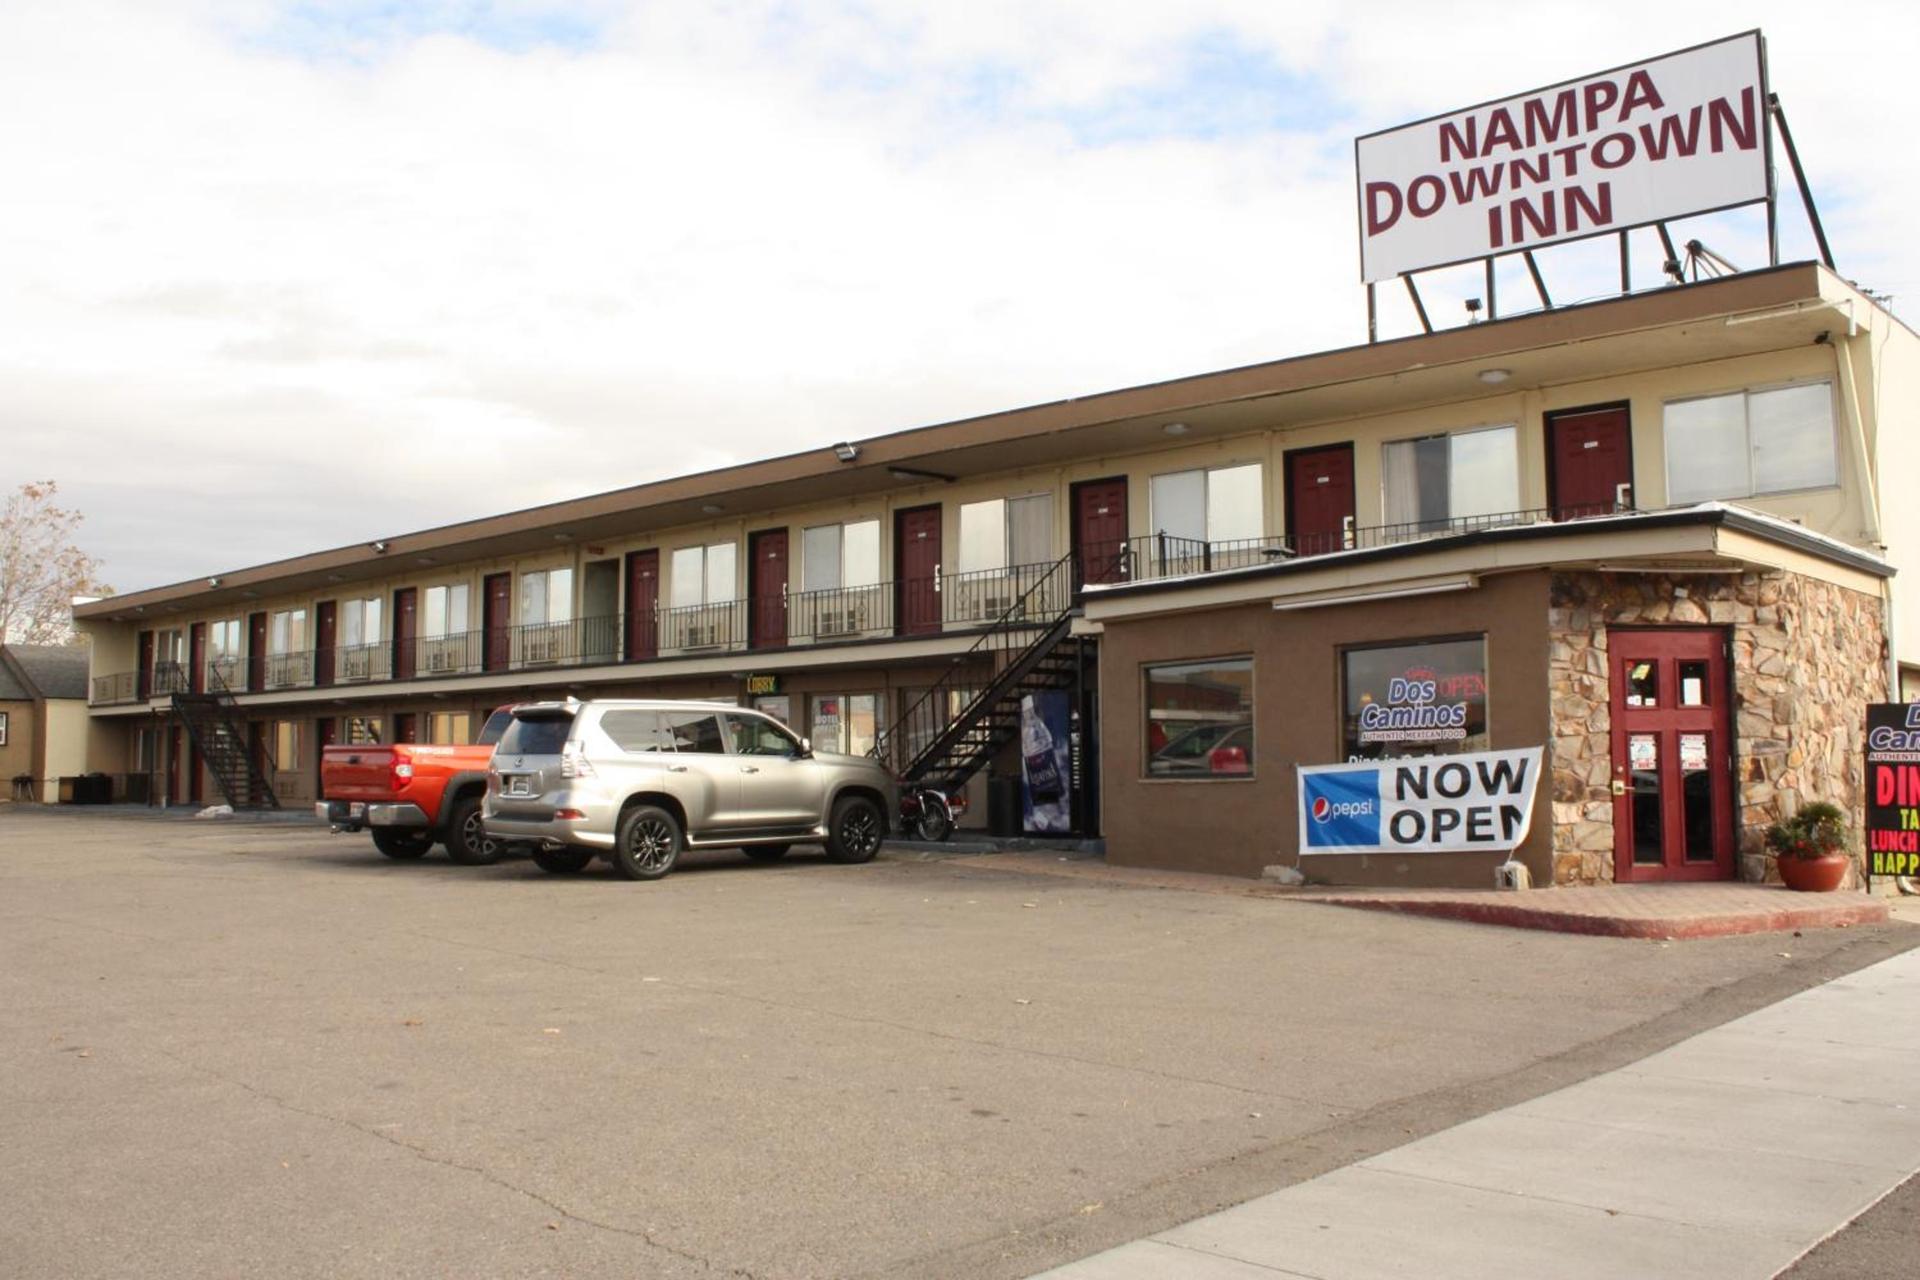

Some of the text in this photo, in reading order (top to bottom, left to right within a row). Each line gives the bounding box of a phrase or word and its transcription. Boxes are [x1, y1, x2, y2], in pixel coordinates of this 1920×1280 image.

[1438, 69, 1665, 163] NAMPA
[1365, 85, 1758, 238] DOWNTOWN
[1488, 181, 1614, 249] INN
[1388, 678, 1436, 704] Dos
[1360, 701, 1467, 730] Caminos
[1362, 728, 1466, 741] AUTHENTIC MEXICAN FOOD
[1396, 757, 1529, 801] NOW
[1330, 799, 1374, 819] pepsi
[1871, 829, 1918, 852] LUNCH
[1873, 852, 1919, 875] HAPP
